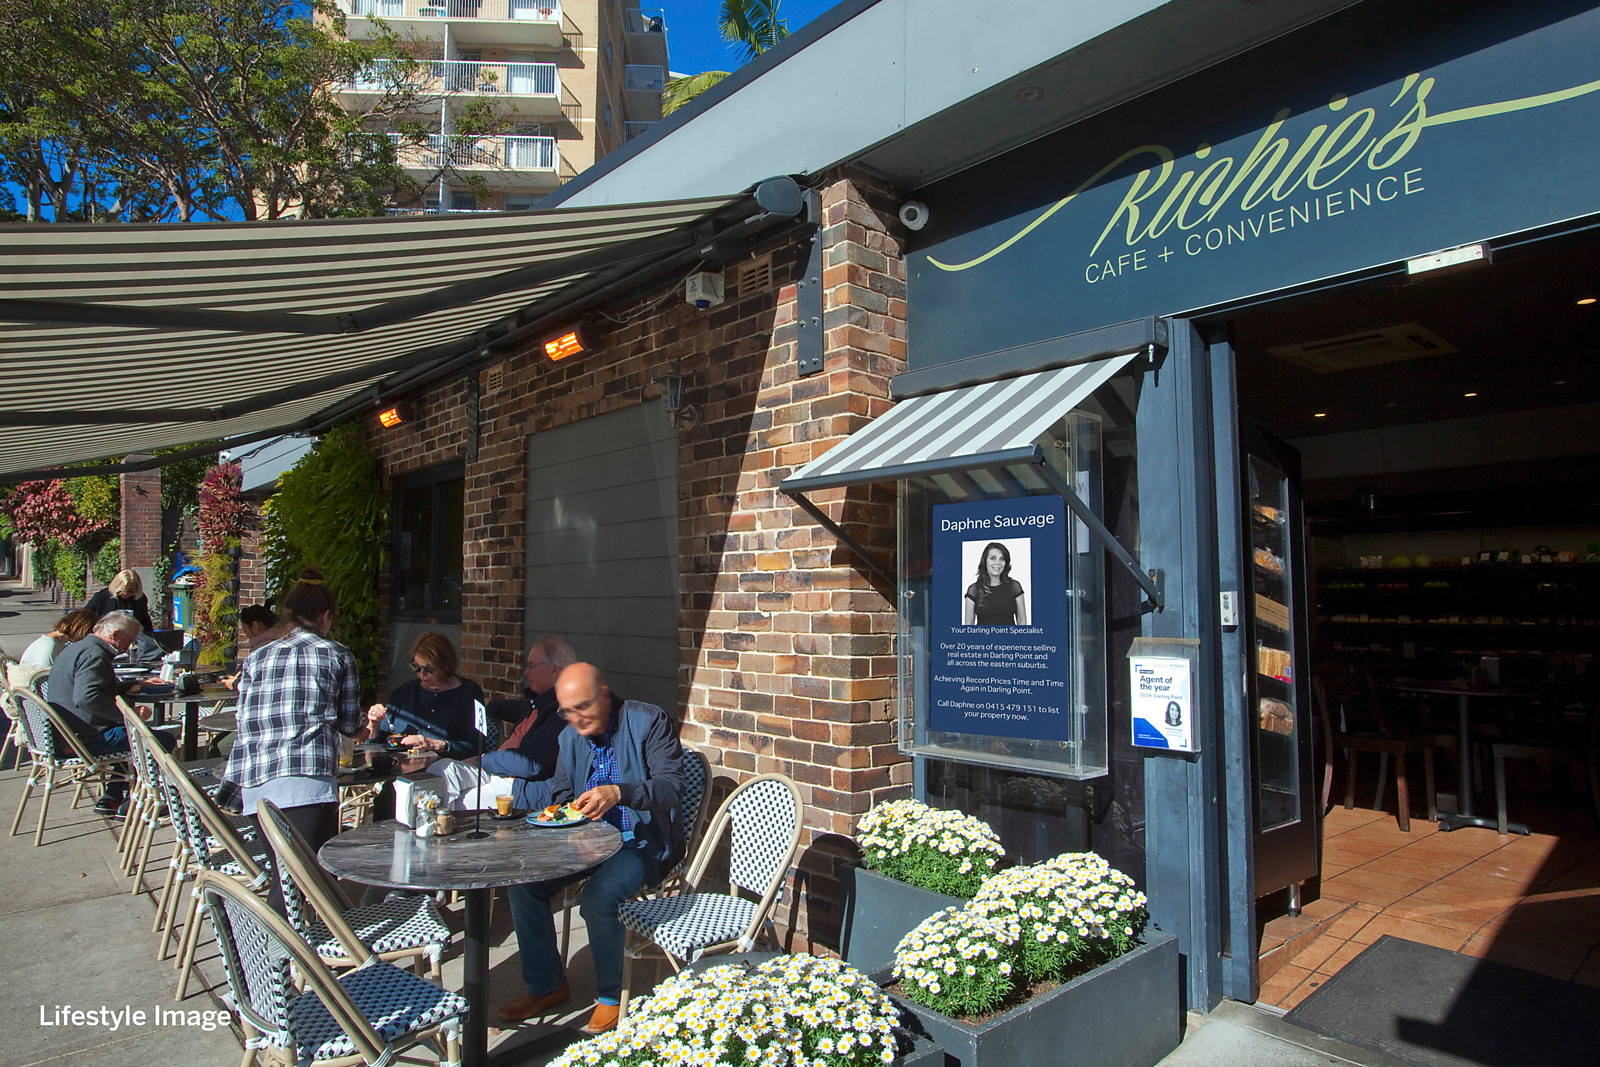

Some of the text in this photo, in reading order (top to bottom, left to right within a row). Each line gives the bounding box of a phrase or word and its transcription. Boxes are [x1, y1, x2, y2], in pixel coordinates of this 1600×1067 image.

[1088, 72, 1436, 258] Richie's
[1085, 167, 1425, 284] CAFE + CONVENIENCE
[941, 514, 1054, 532] Daphne Sauvage
[934, 676, 965, 684] Achieving
[1140, 675, 1163, 684] Agent
[988, 686, 1011, 695] Darling
[950, 701, 975, 710] Daphne
[980, 712, 1010, 720] property
